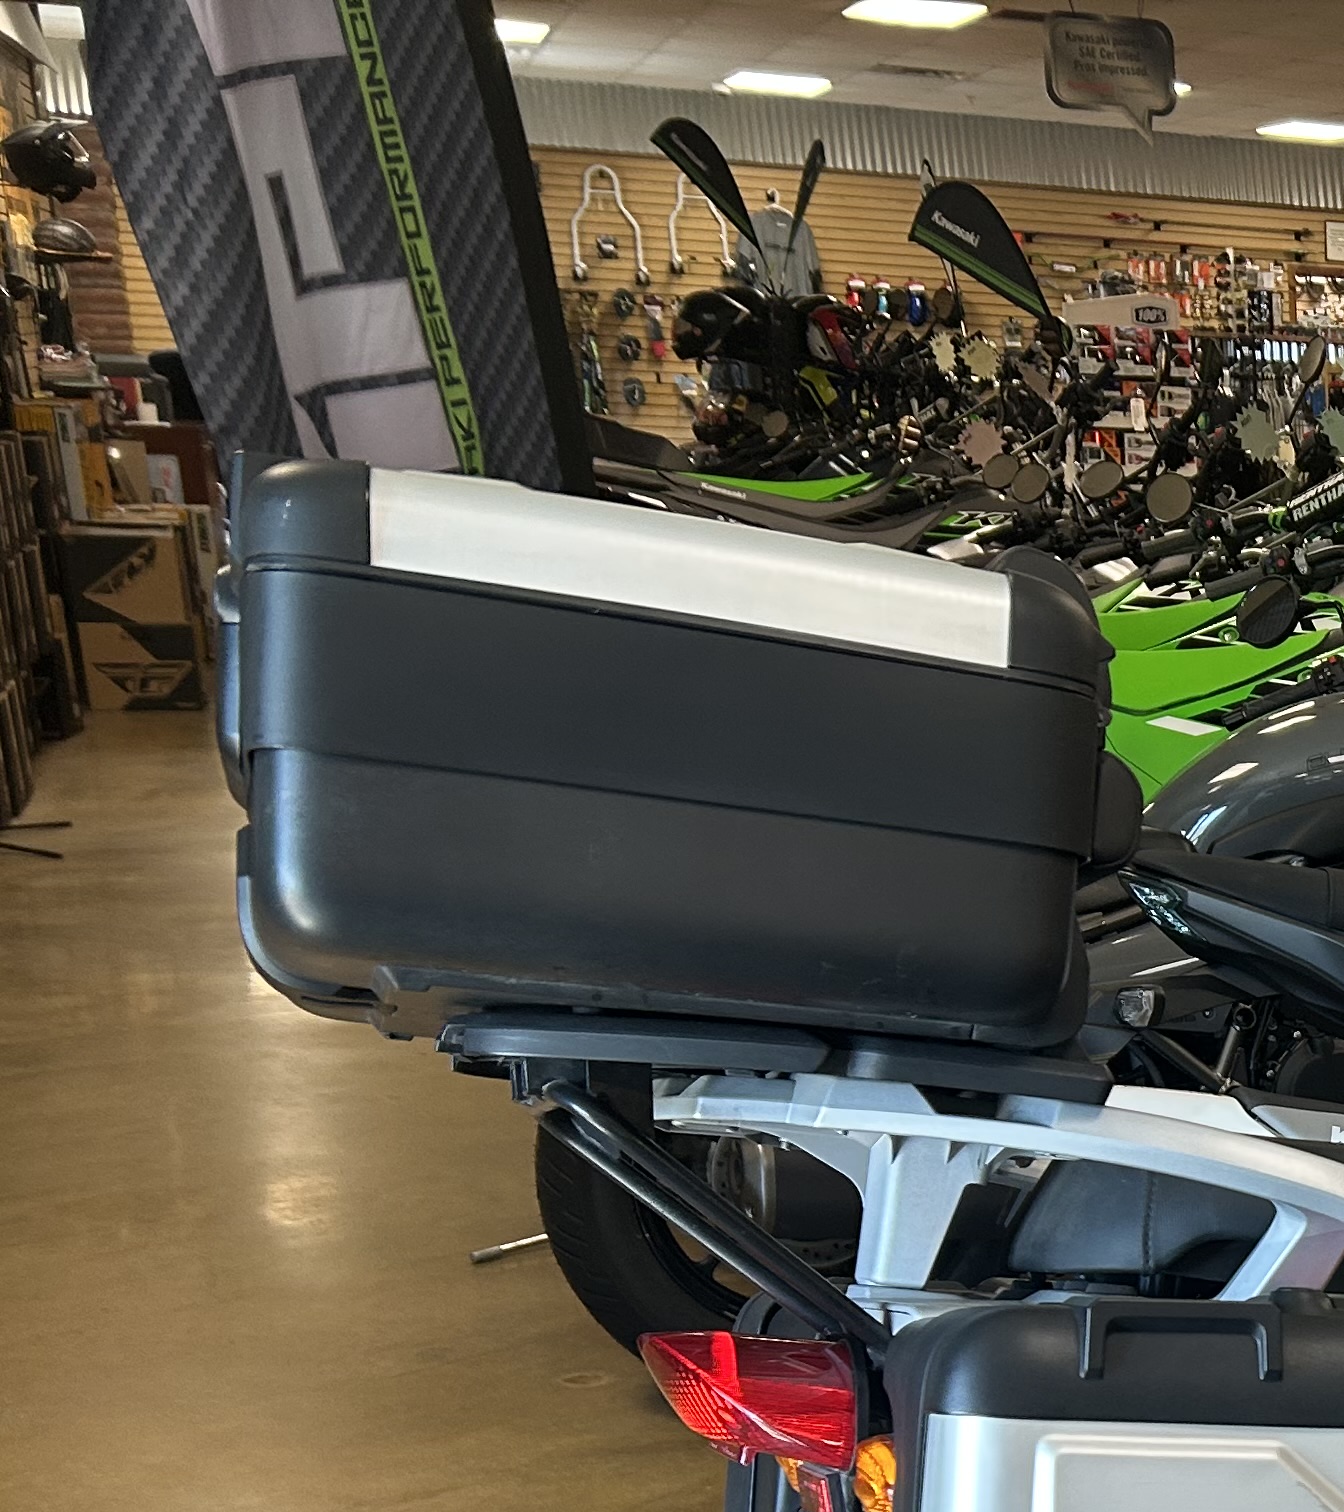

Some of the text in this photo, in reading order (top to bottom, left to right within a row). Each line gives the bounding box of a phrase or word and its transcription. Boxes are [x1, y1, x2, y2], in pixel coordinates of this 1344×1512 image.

[1065, 30, 1110, 46] Kawasaki
[1078, 45, 1096, 59] SAE
[346, 0, 462, 386] PERFORMANC
[930, 209, 981, 248] Kawasaki
[1137, 306, 1166, 321] 100%
